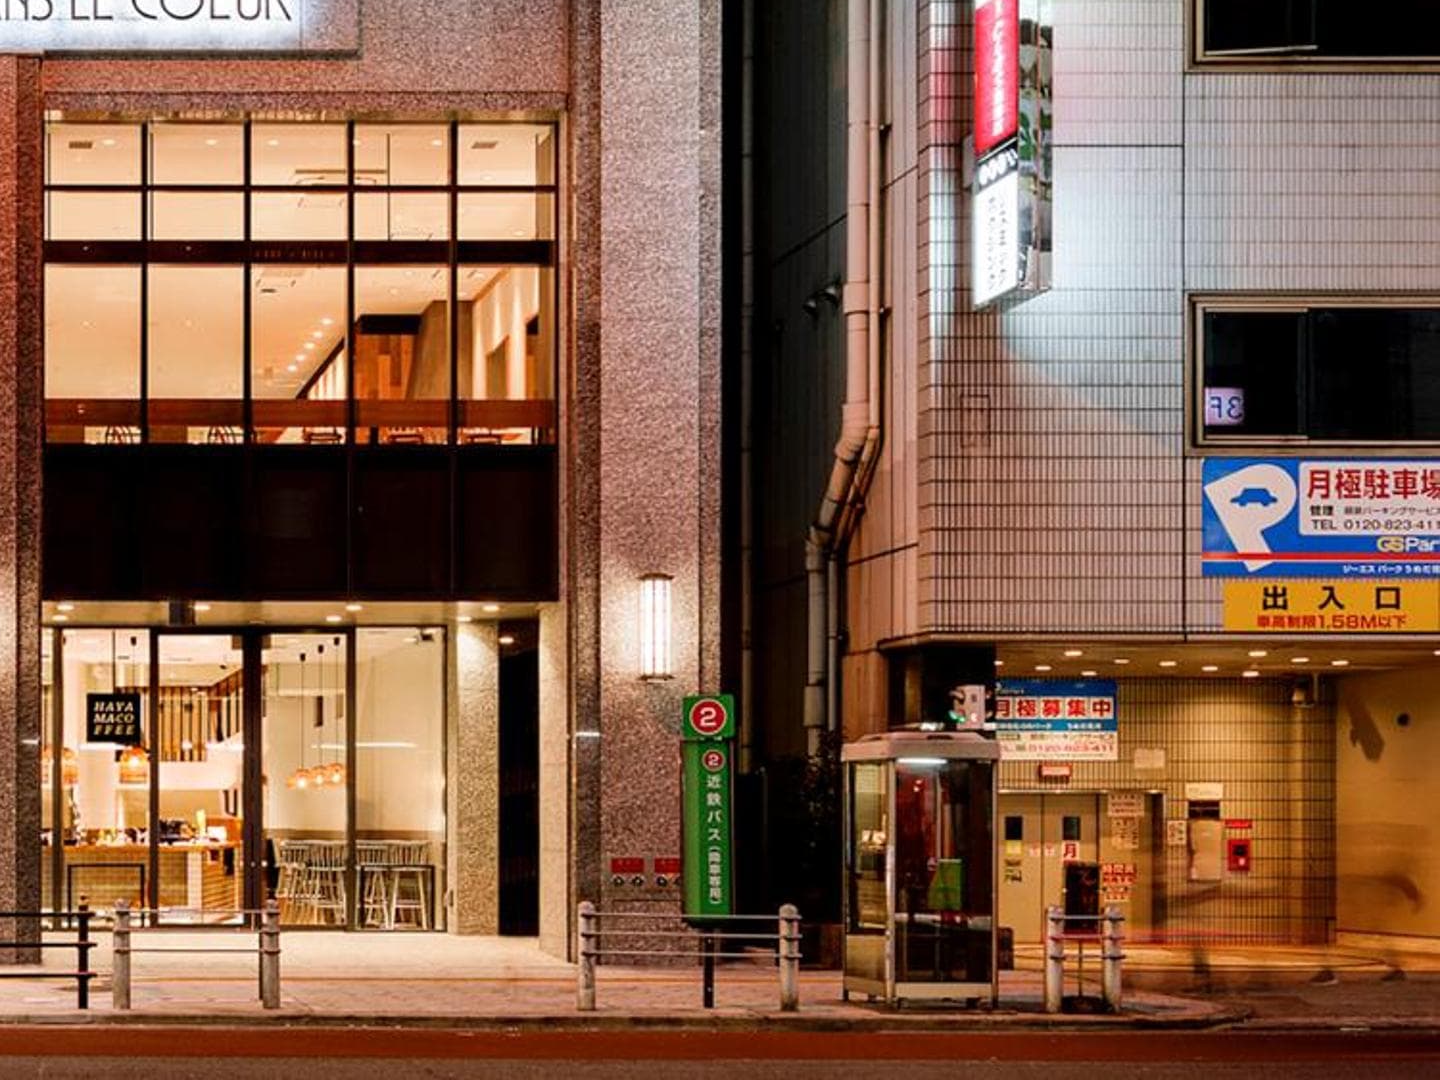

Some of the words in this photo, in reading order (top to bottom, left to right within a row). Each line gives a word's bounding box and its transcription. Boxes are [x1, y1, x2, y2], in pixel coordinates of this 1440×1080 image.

[1308, 469, 1440, 499] 月極駐車場
[1312, 519, 1337, 530] TEL
[1262, 585, 1402, 611] 出入口
[93, 701, 134, 712] HAYA
[93, 712, 135, 724] MACO
